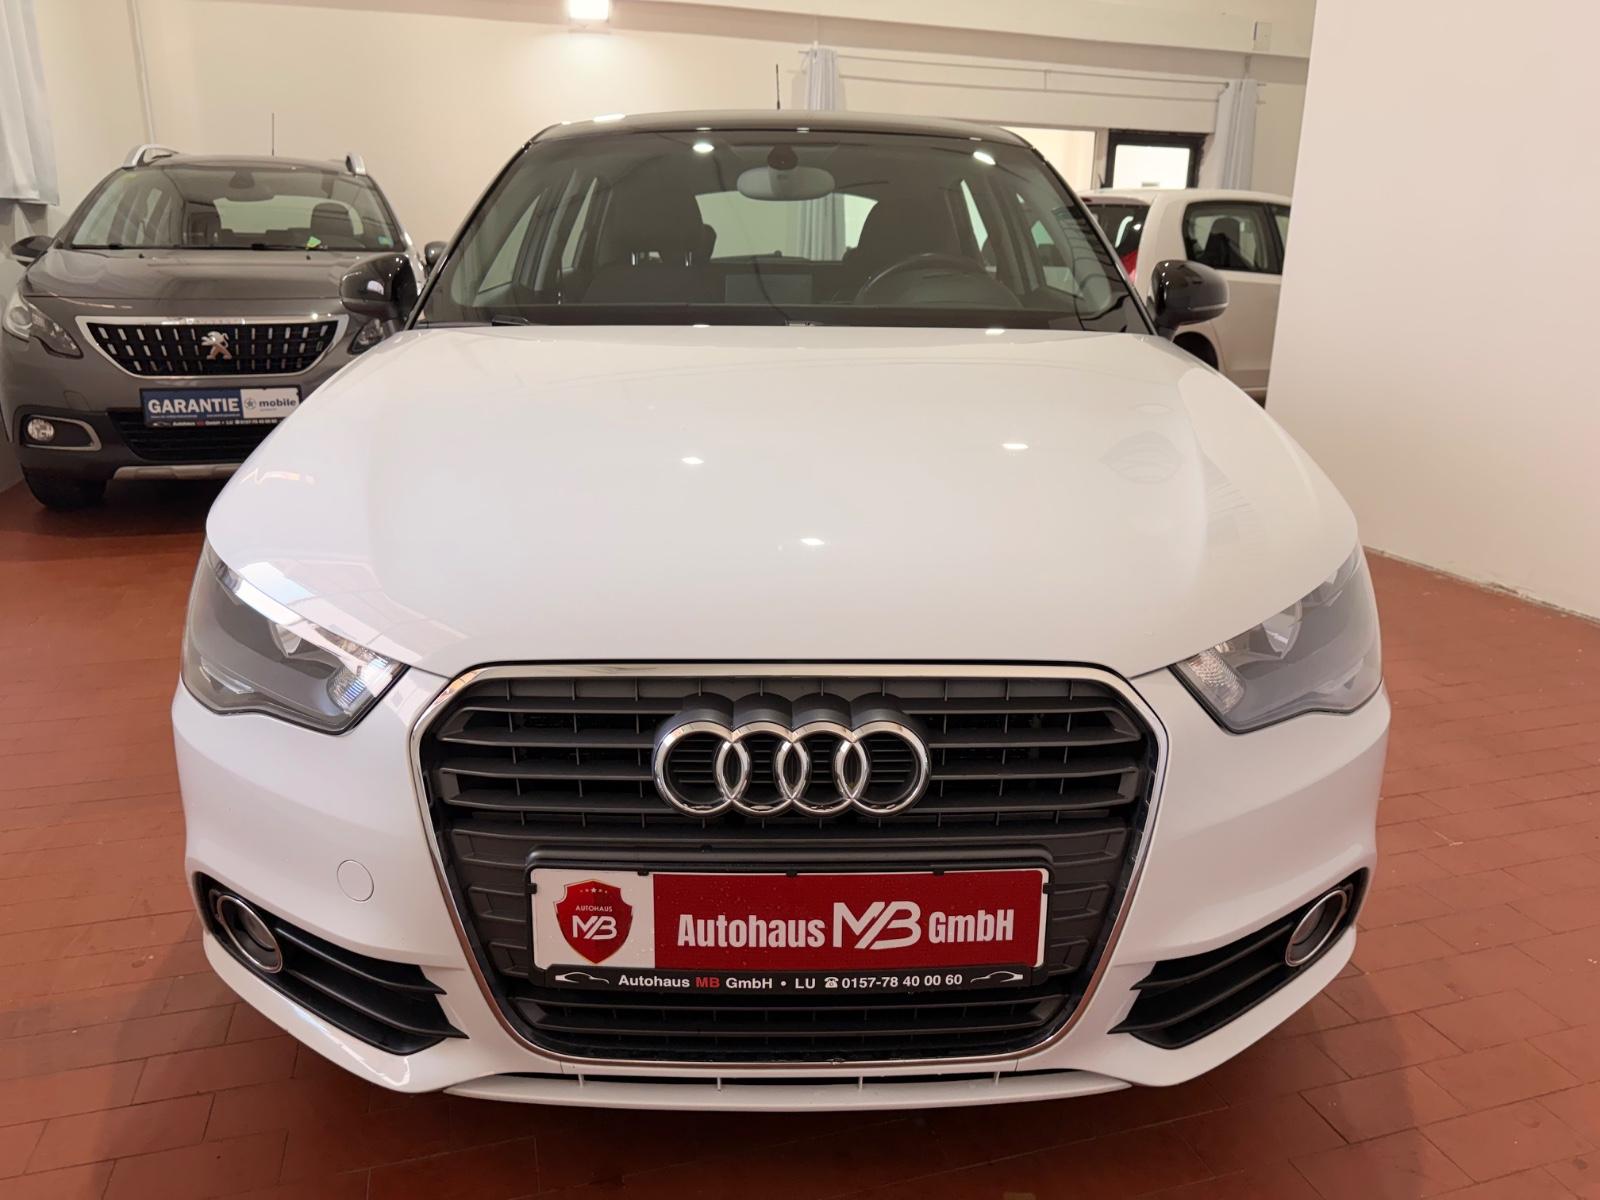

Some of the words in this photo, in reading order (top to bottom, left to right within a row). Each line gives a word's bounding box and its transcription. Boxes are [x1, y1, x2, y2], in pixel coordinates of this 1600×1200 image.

[148, 398, 240, 414] GARANTIE
[258, 397, 297, 408] mobile
[575, 904, 613, 913] AUTOHAUS
[572, 915, 618, 940] MB
[678, 914, 826, 948] Autohaus
[832, 901, 922, 951] MB
[928, 909, 1015, 944] GmbH
[618, 974, 690, 988] Autohaus
[695, 976, 720, 988] MB
[725, 977, 773, 989] GmbH
[795, 978, 816, 989] LU
[842, 976, 898, 989] 0157-78
[902, 975, 920, 987] 40
[923, 975, 941, 987] 00
[945, 974, 963, 986] 60
